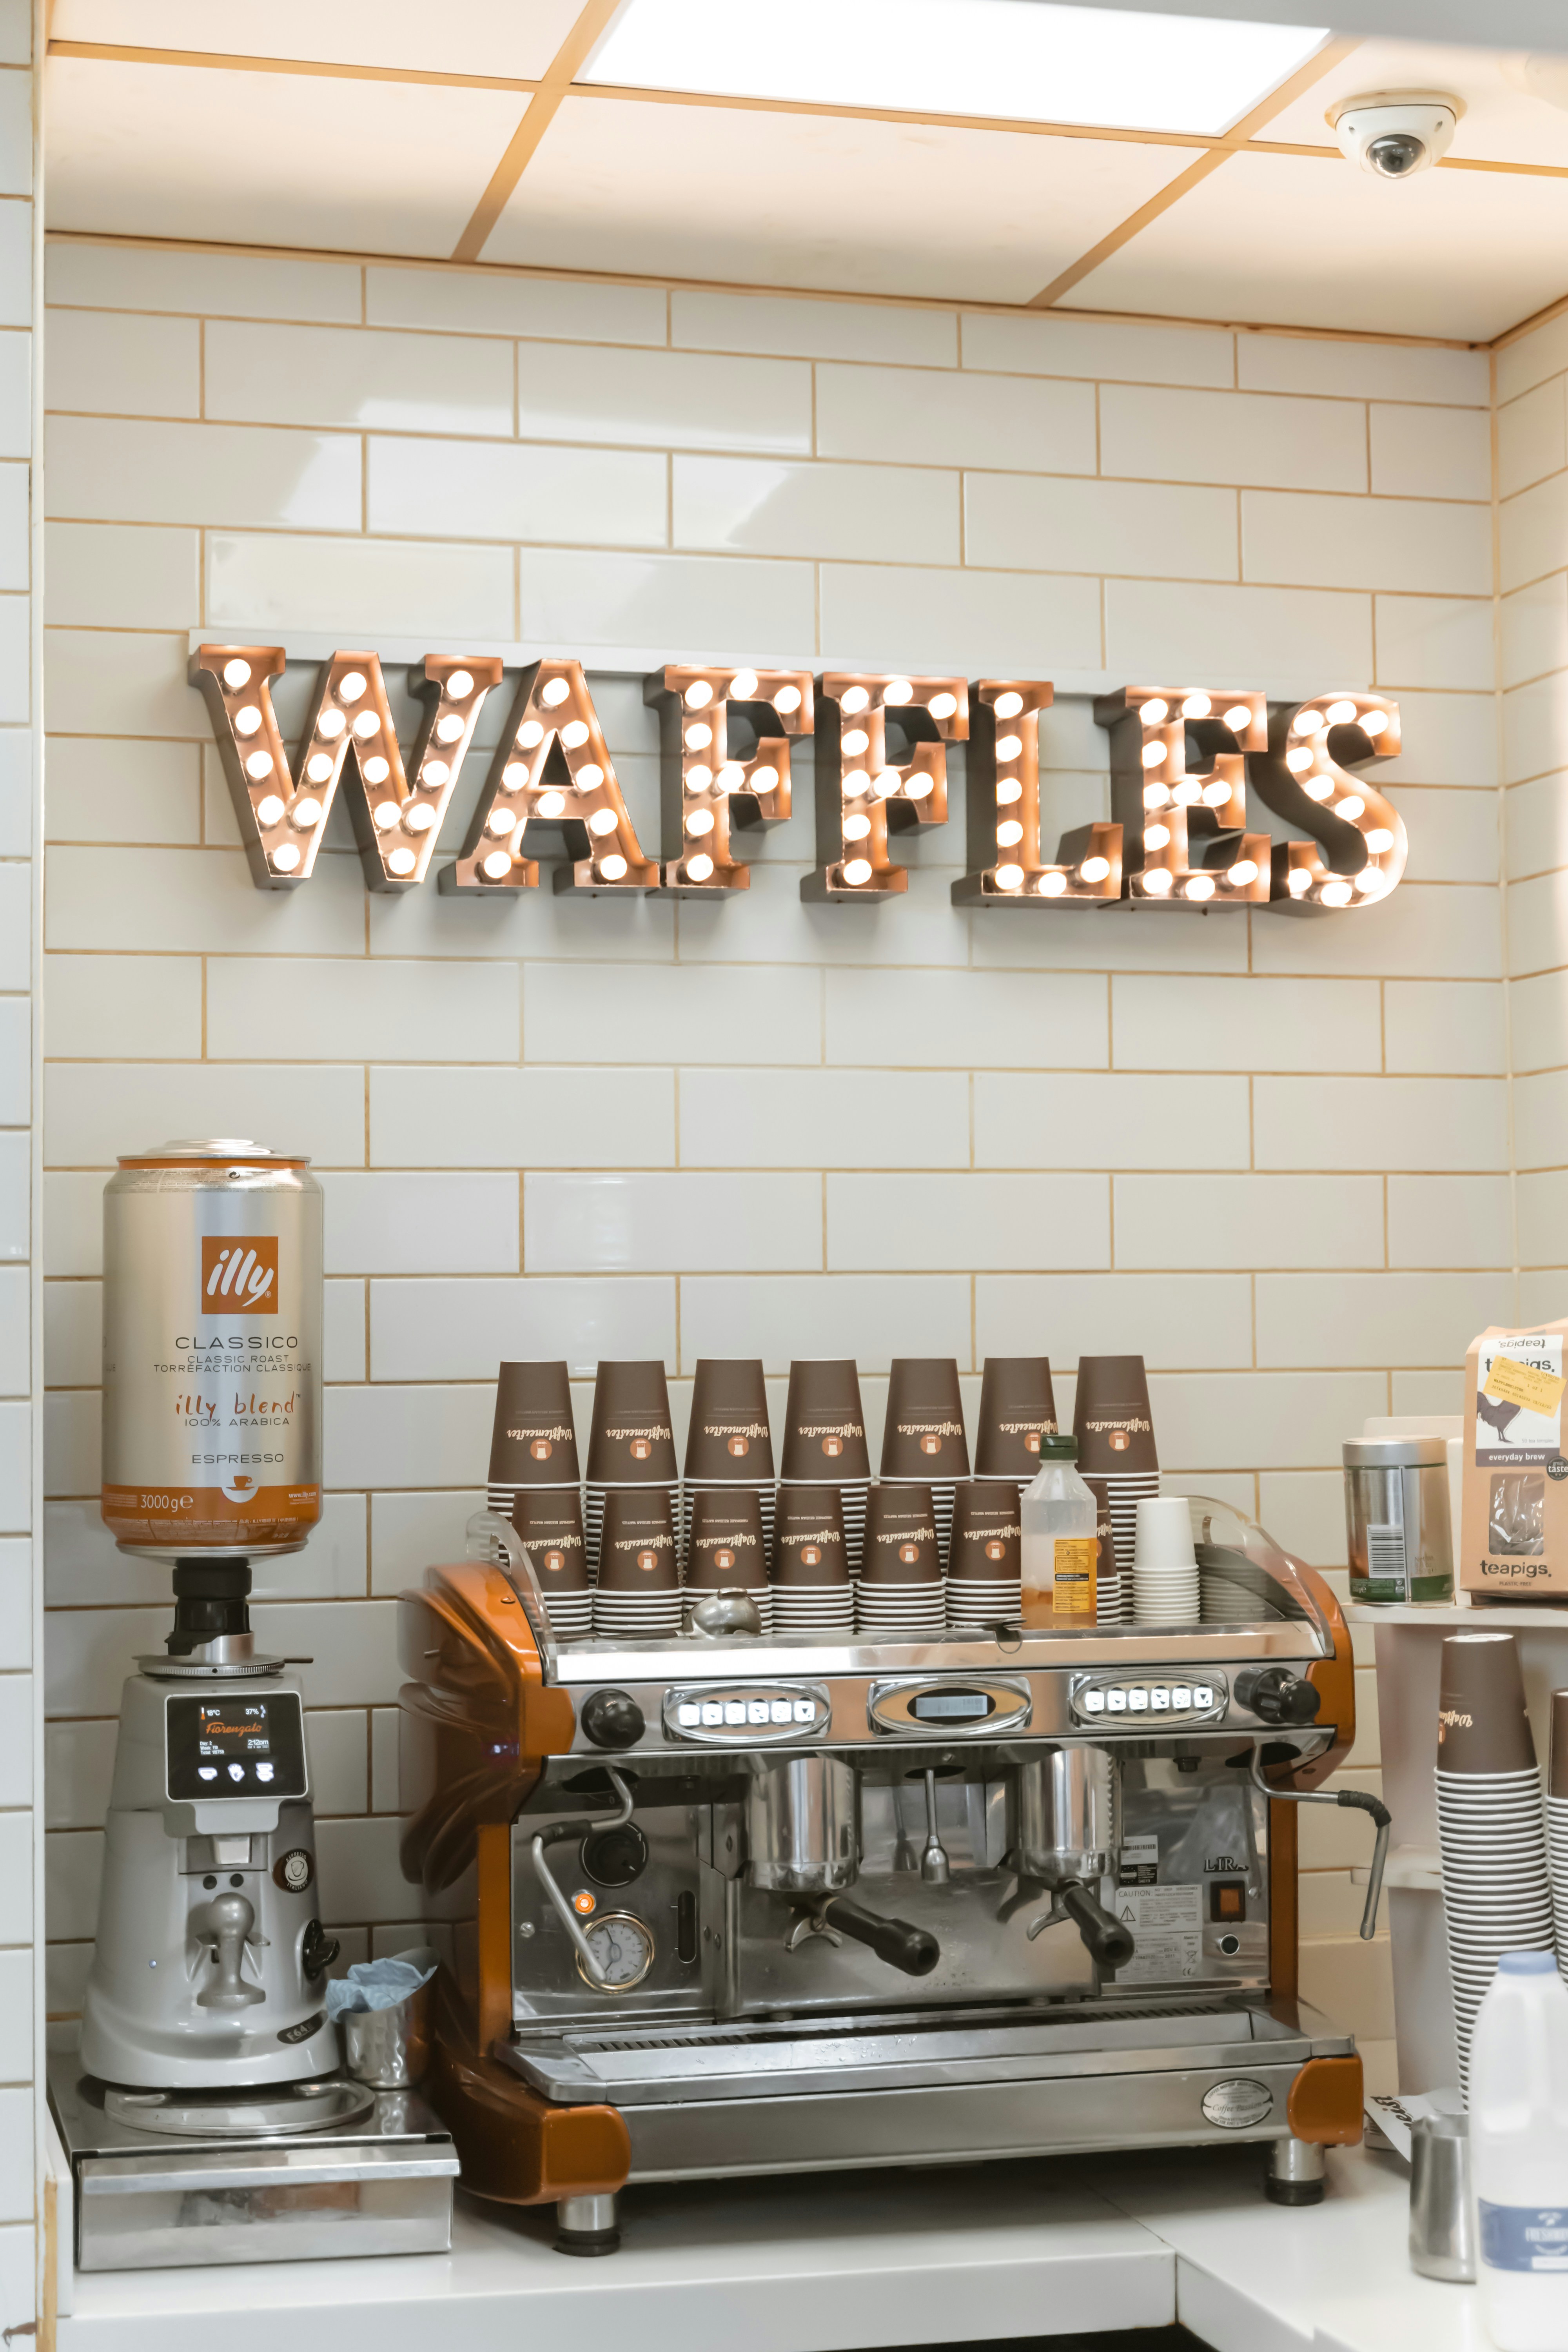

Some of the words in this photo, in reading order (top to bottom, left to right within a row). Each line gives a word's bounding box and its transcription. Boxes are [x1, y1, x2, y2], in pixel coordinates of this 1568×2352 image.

[187, 644, 1409, 913] WAFFLES
[207, 1248, 274, 1307] illy
[175, 1336, 298, 1349] CLASSICO
[154, 1363, 250, 1372] TORRÉFACTION
[256, 1363, 311, 1372] CLASSIQUE
[176, 1394, 216, 1421] illy
[235, 1391, 294, 1415] blend
[229, 1417, 289, 1426] ARABICA
[192, 1454, 284, 1464] ESPRESSO
[1489, 1453, 1523, 1462] everyday
[1480, 1560, 1552, 1578] teapigs.
[206, 1722, 262, 1737] Fiorenzato
[1212, 2104, 1234, 2115] Coffee
